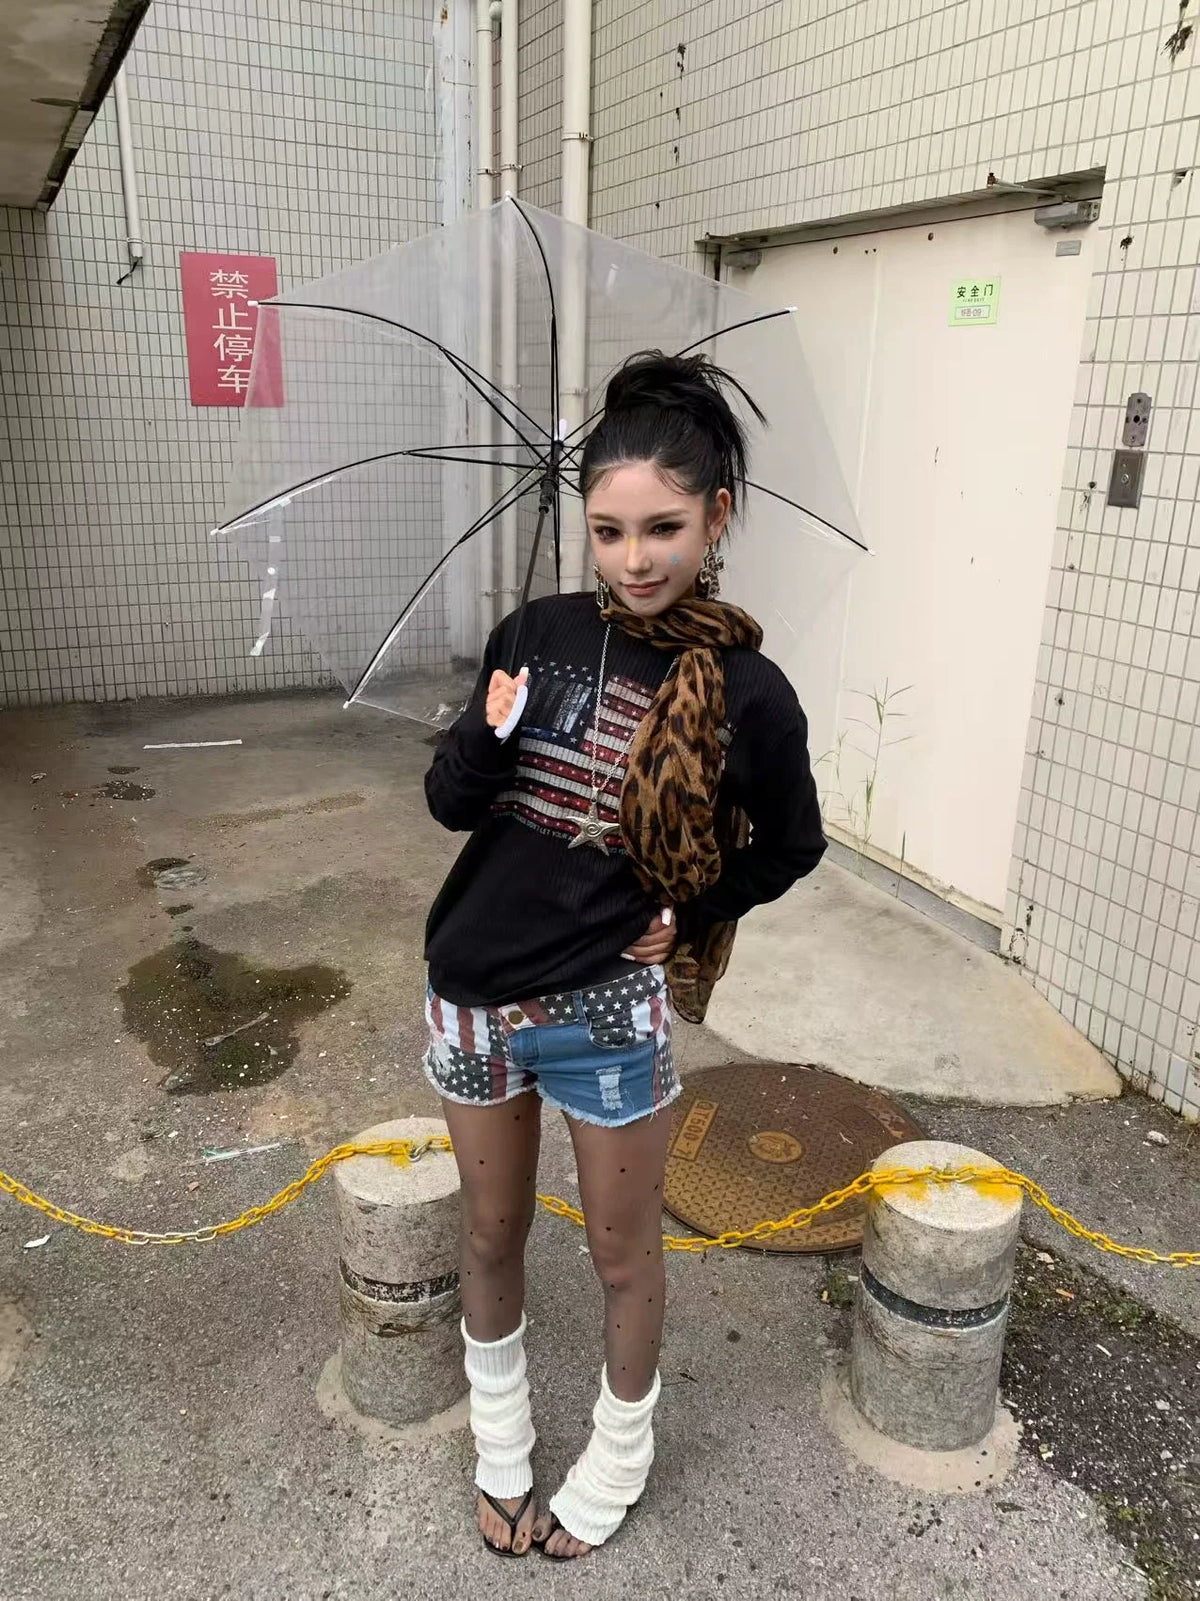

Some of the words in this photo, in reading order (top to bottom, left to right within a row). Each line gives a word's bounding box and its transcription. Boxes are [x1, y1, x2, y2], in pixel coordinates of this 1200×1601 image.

[956, 283, 994, 299] 安全门
[209, 268, 253, 393] 禁止停车
